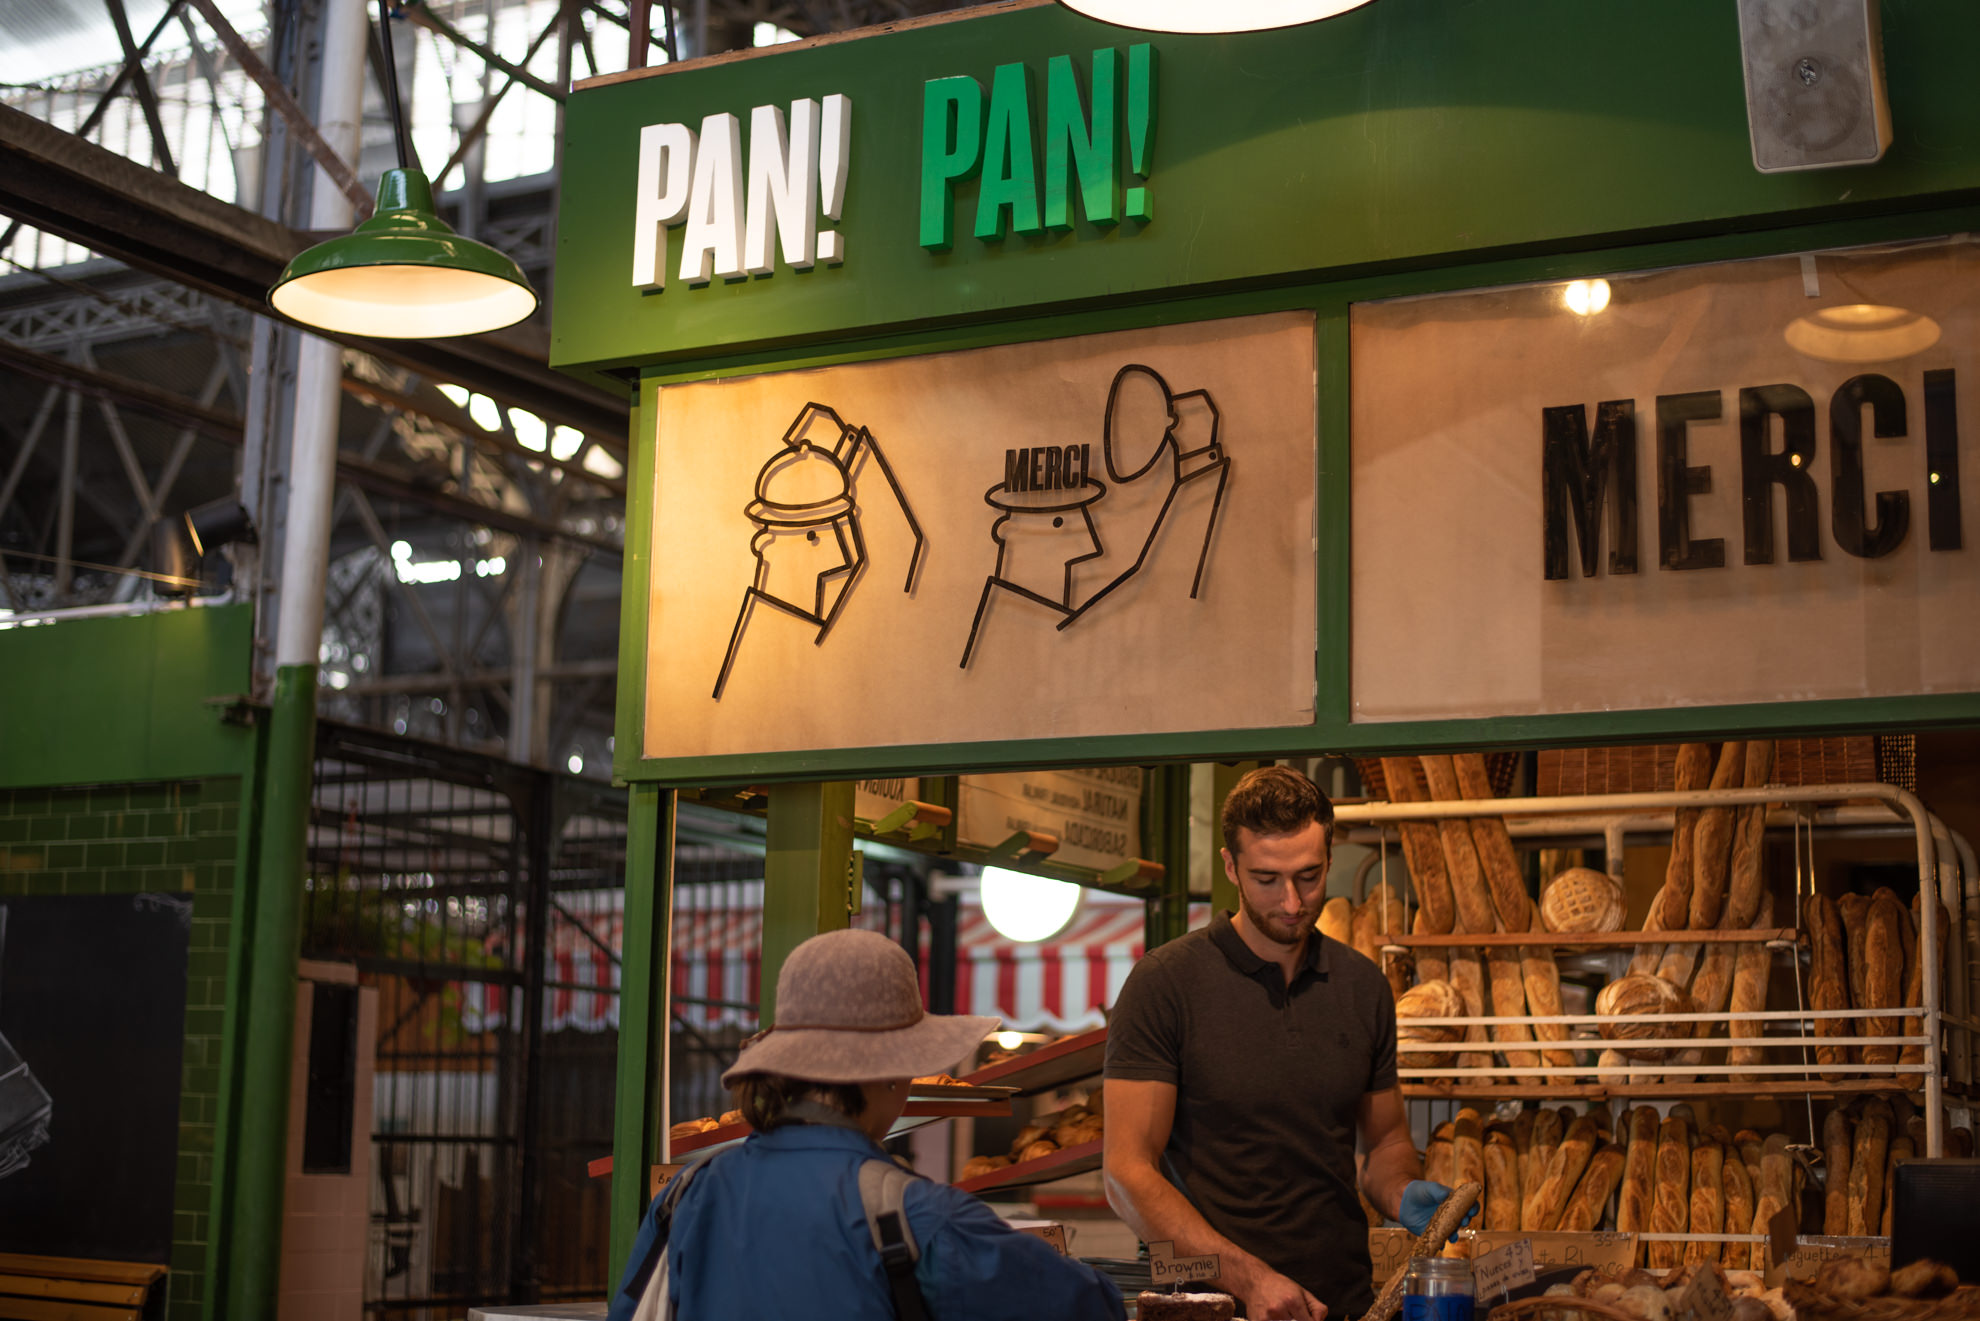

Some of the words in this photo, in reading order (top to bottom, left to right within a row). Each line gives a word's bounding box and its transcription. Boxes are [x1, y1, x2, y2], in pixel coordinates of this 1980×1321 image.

[632, 93, 851, 290] PAN!
[920, 43, 1159, 251] PAN!
[1004, 443, 1090, 493] MERCI
[1542, 368, 1962, 580] MERCI
[1154, 1259, 1214, 1276] Brownie
